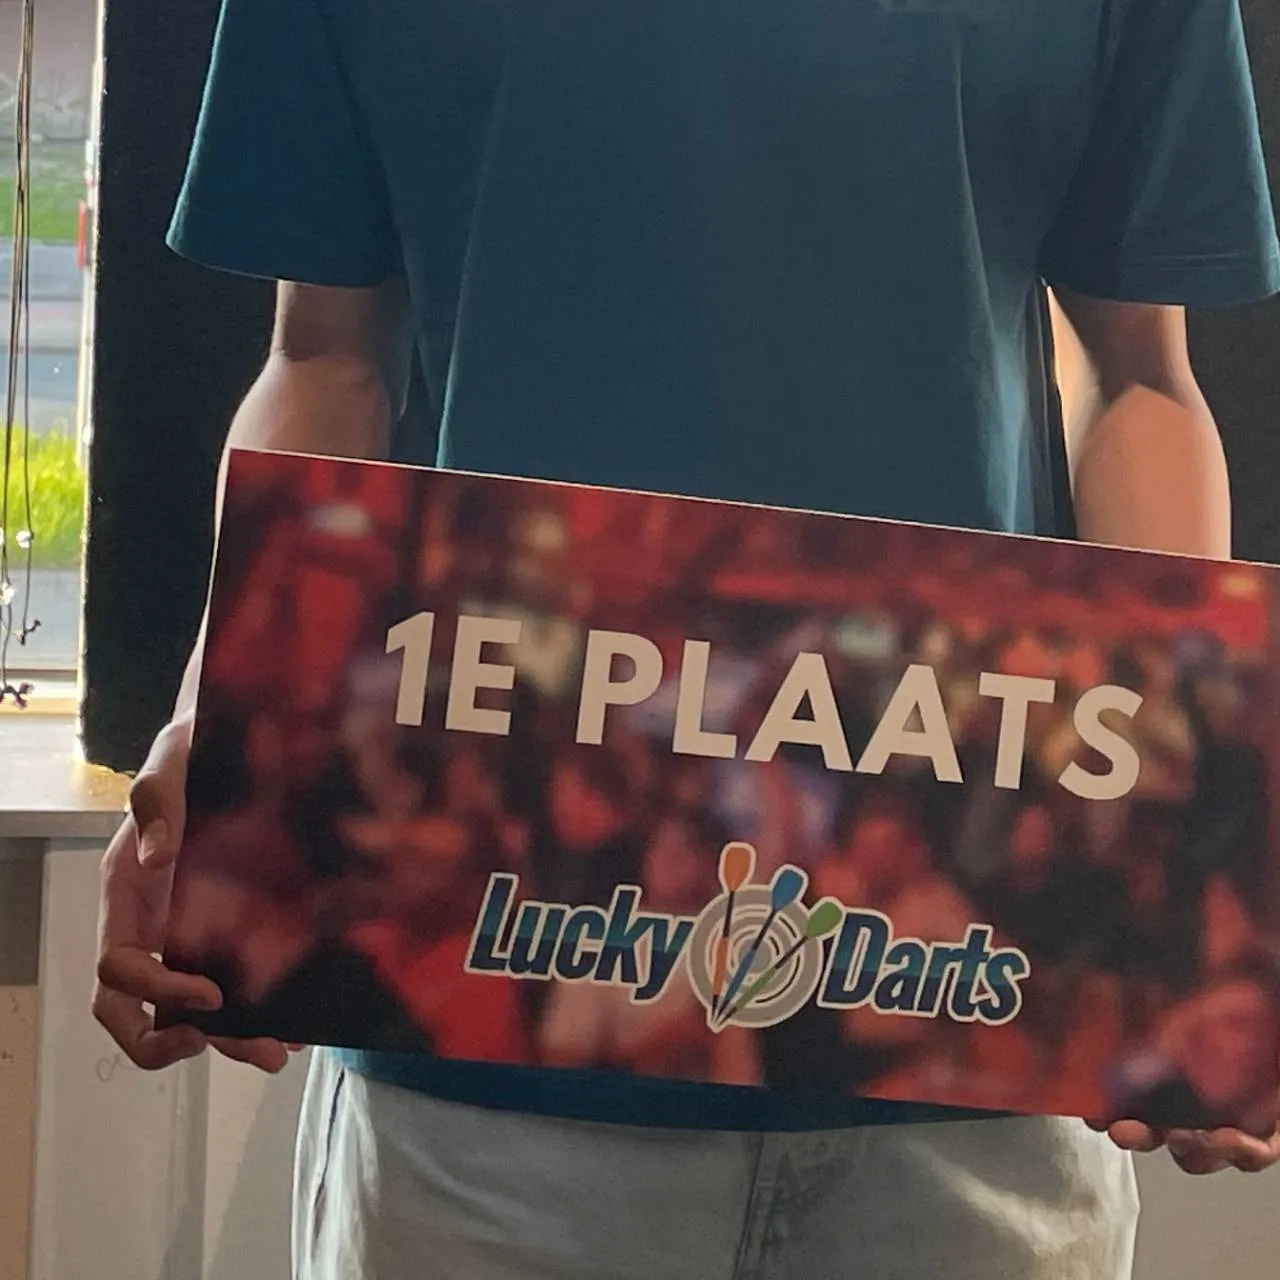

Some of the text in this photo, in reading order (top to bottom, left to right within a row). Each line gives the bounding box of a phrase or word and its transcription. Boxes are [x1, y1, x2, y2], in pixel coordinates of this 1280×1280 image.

[384, 610, 1145, 801] 1E PLAATS
[464, 871, 1031, 1026] Lucky Darts
